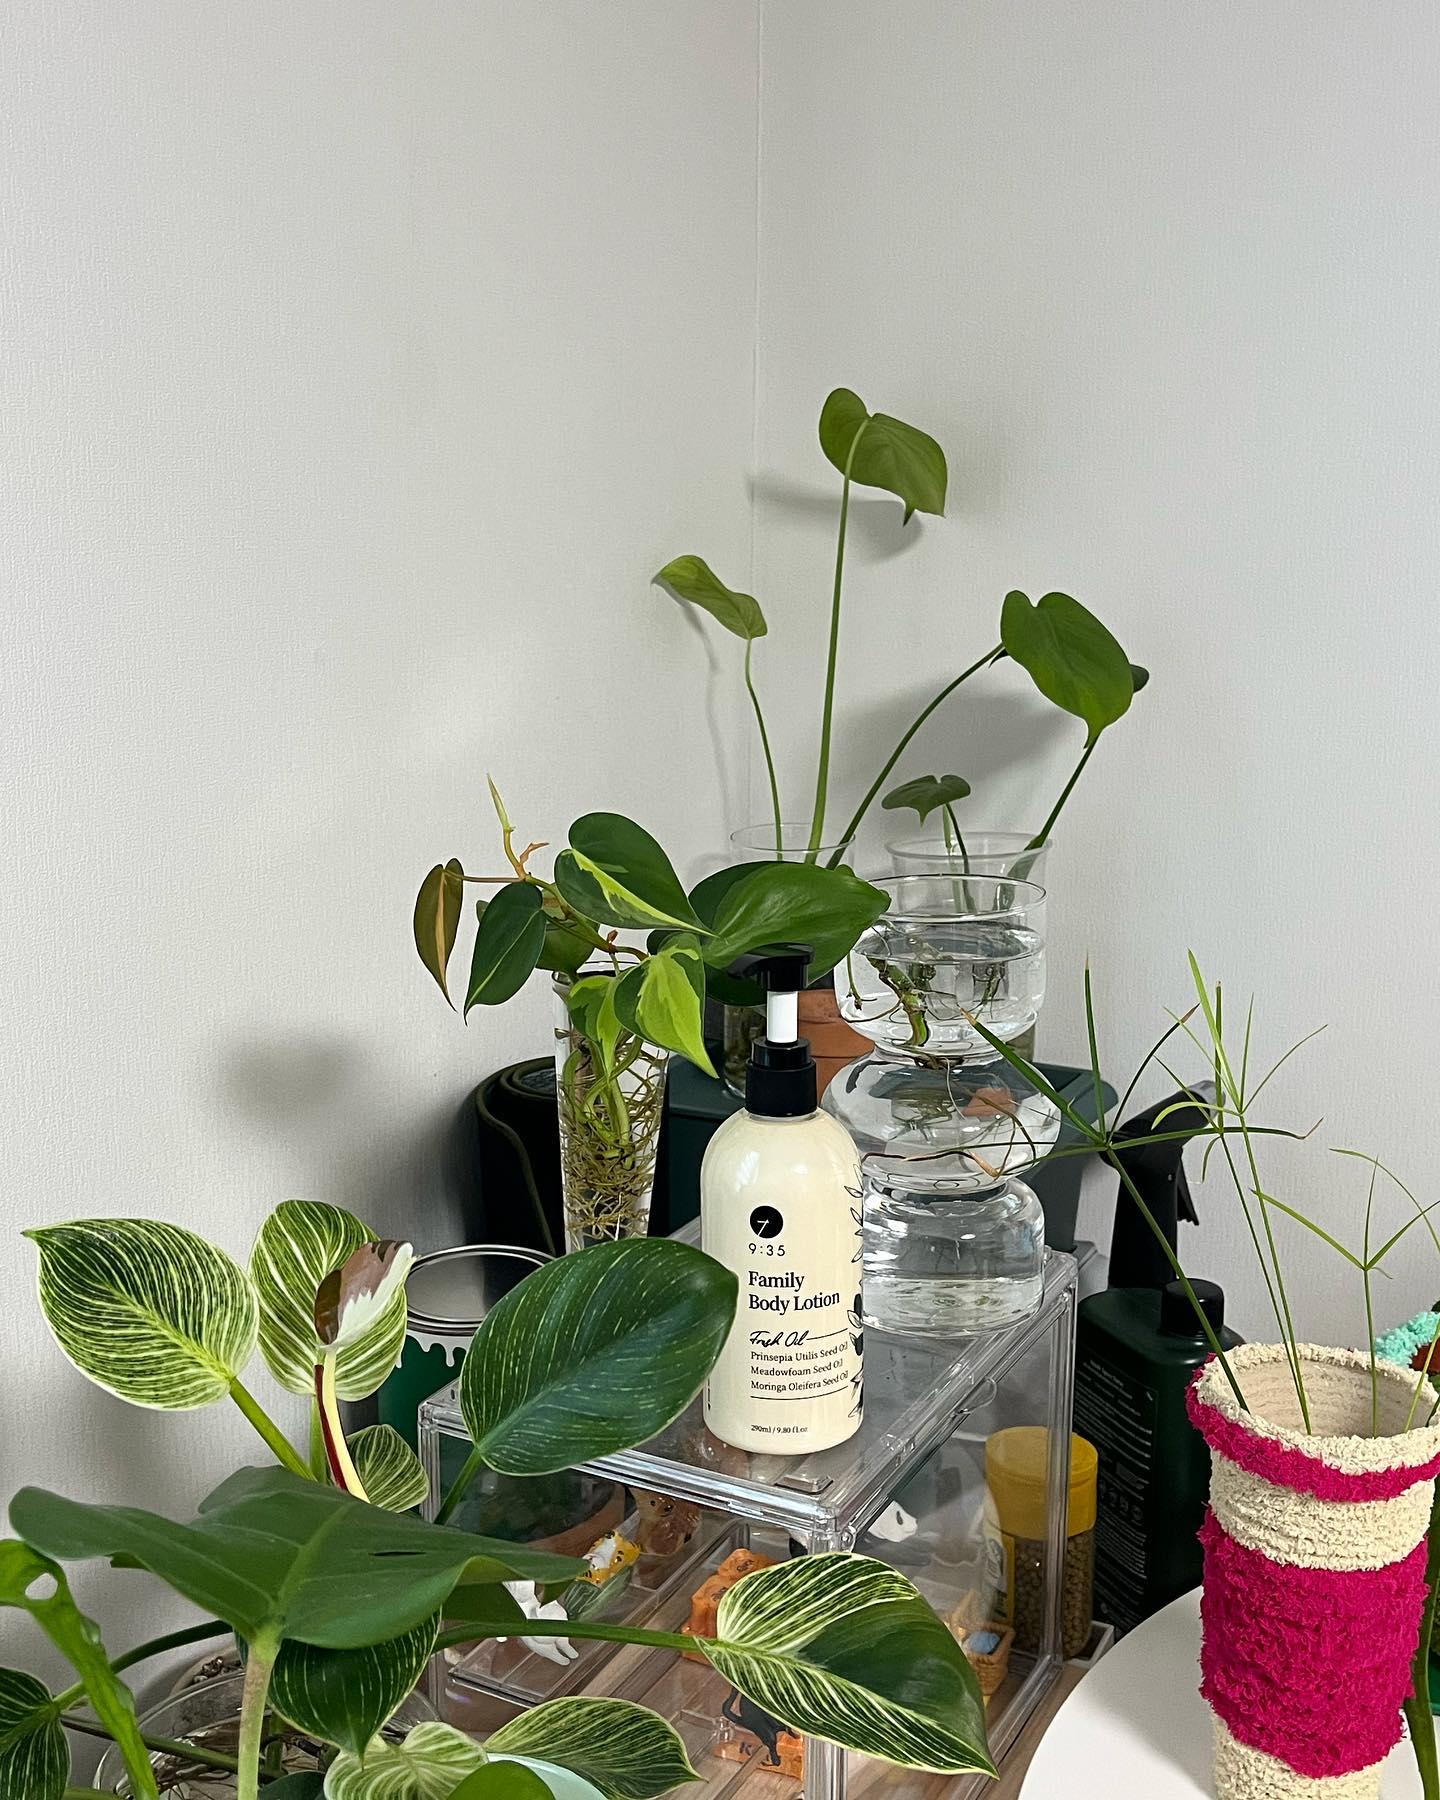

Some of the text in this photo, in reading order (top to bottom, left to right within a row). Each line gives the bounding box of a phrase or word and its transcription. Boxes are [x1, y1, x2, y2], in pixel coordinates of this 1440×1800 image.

[748, 1242, 786, 1257] 9:35
[748, 1270, 805, 1292] Family
[748, 1292, 840, 1316] Body Lotion
[750, 1351, 793, 1364] Prinsepia
[795, 1351, 819, 1362] Utilis
[820, 1346, 838, 1358] Seed
[750, 1365, 812, 1377] Meadowfoam
[812, 1362, 832, 1374] Seed
[750, 1380, 787, 1393] Moringa
[788, 1381, 822, 1391] Oleifera
[822, 1374, 839, 1387] Seed
[750, 1424, 771, 1433] 290ml
